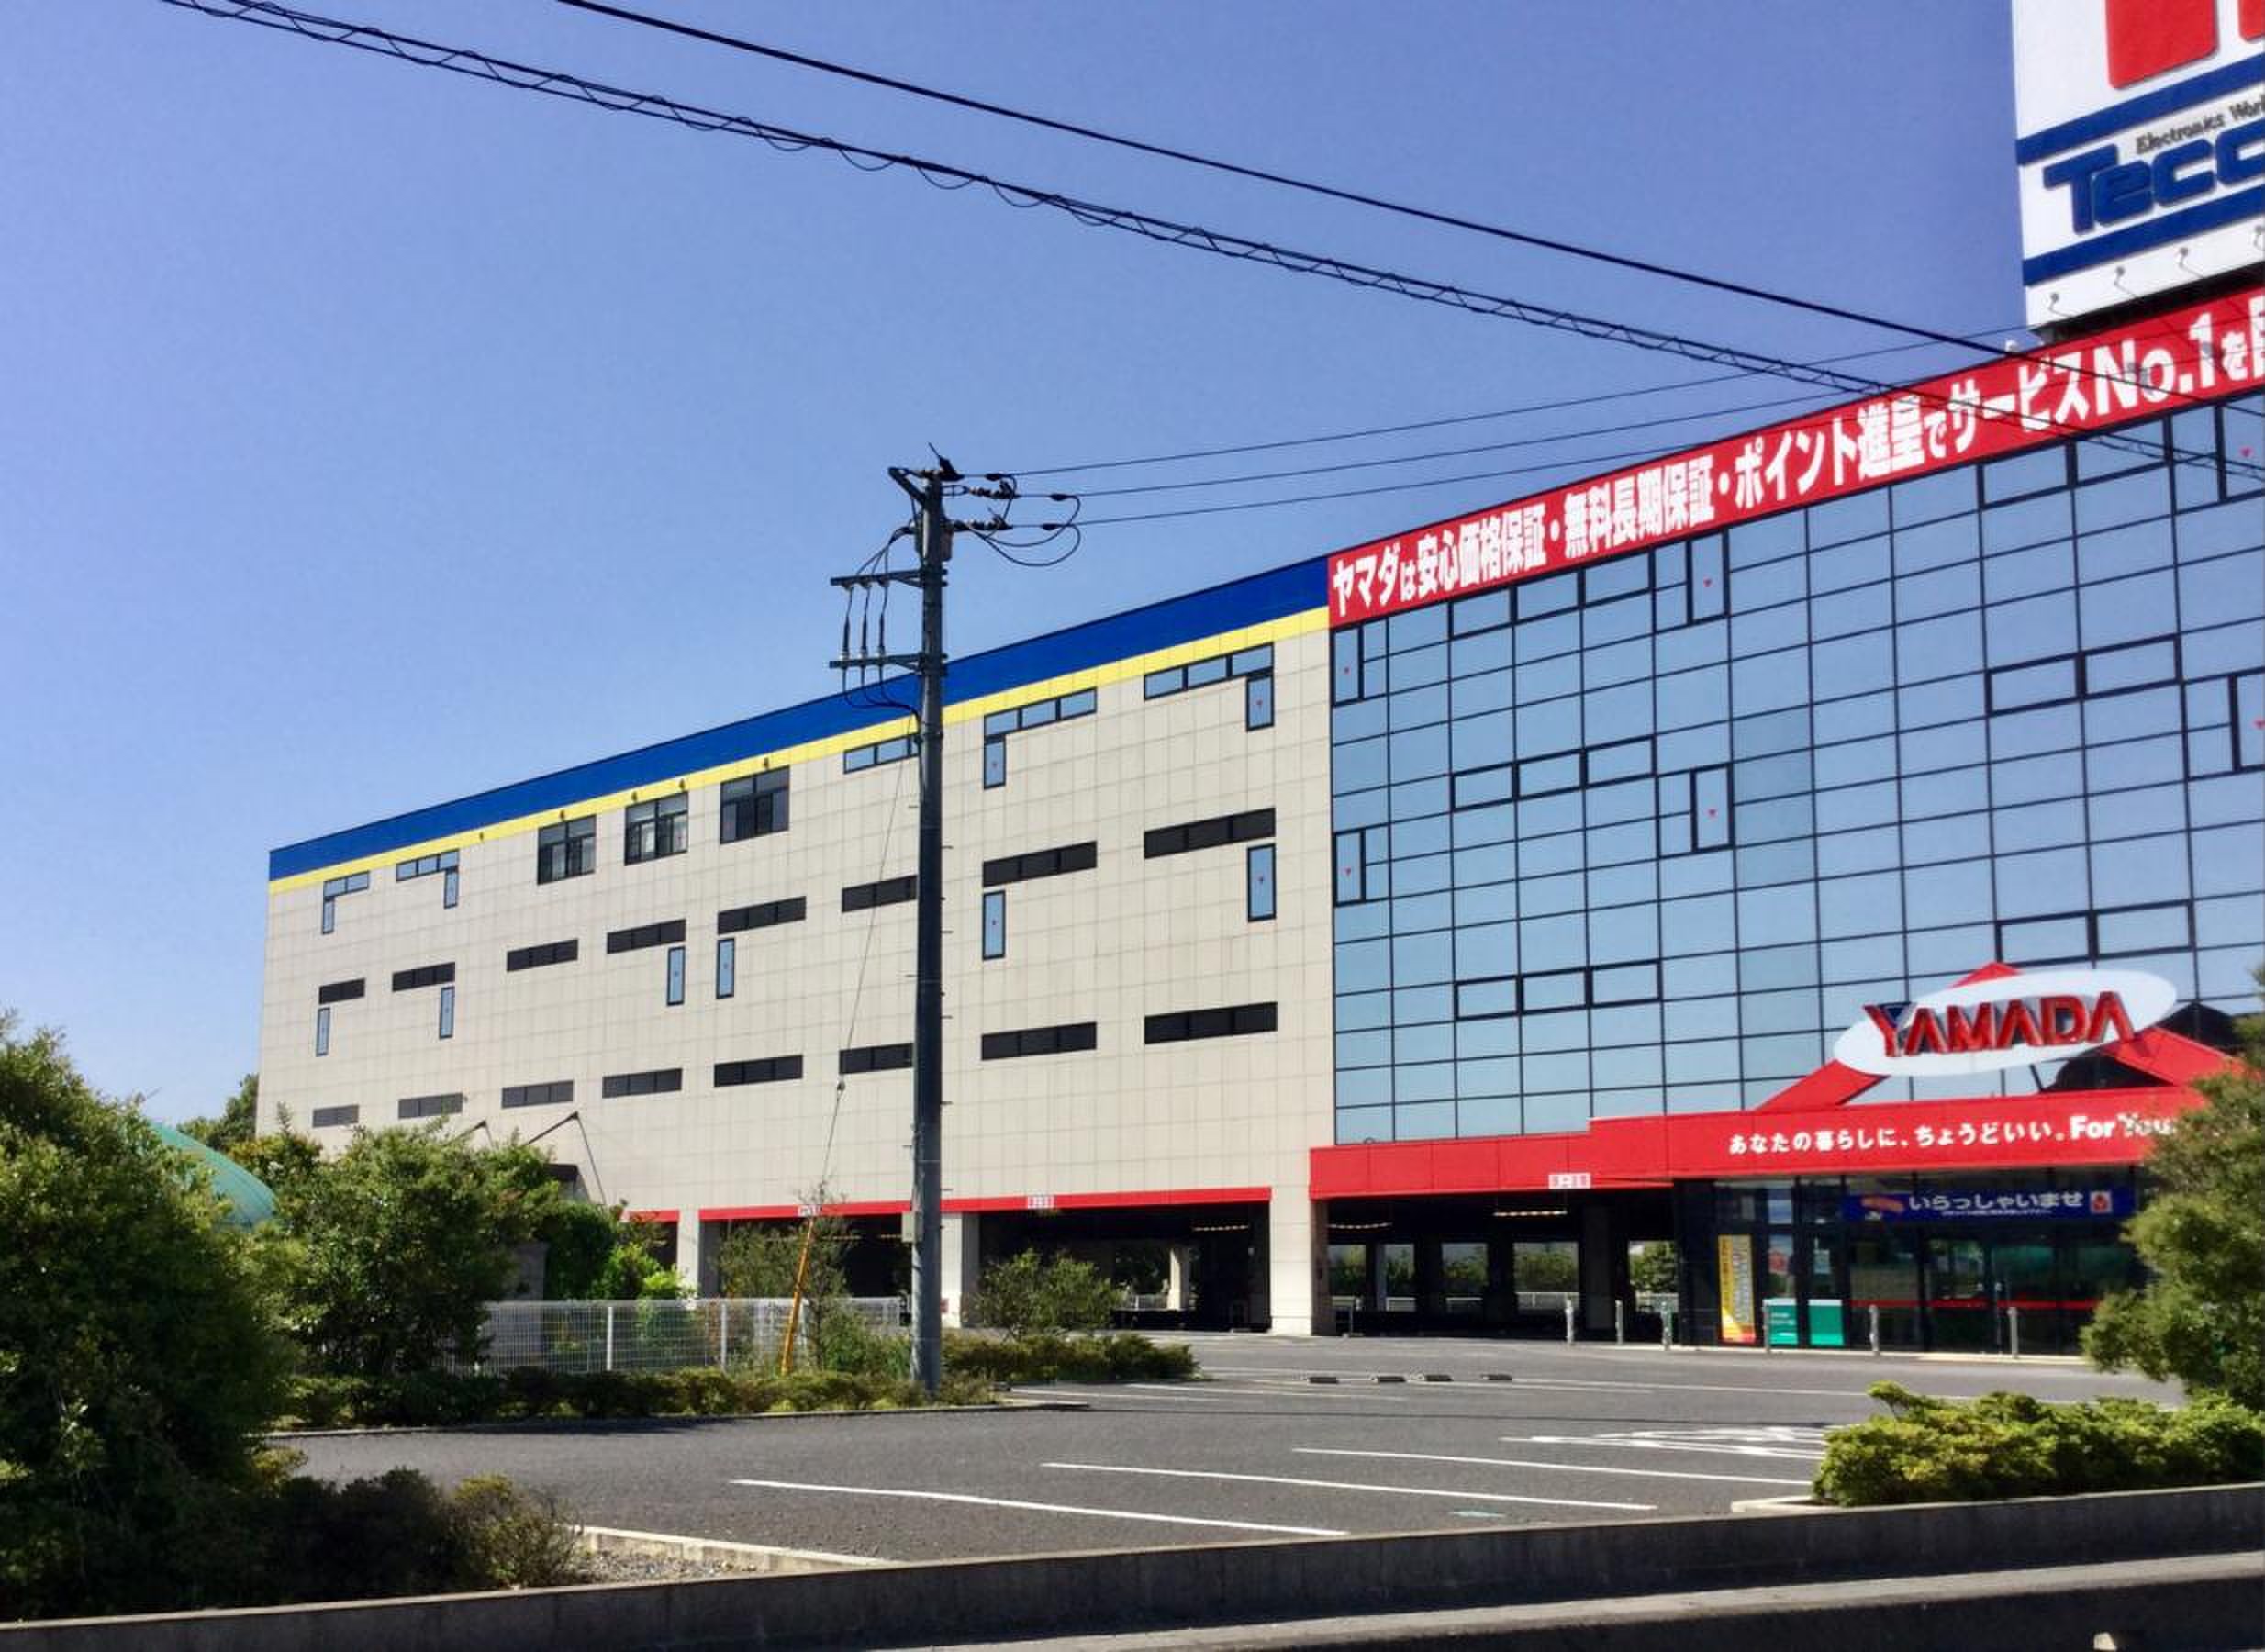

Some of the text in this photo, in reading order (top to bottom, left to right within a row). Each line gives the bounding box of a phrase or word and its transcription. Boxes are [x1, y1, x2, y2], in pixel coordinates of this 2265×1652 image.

[2136, 114, 2226, 154] Electronics
[1863, 990, 2135, 1057] YAMADA
[2070, 1115, 2116, 1139] For
[1908, 1192, 2084, 1210] いらっしゃいませ
